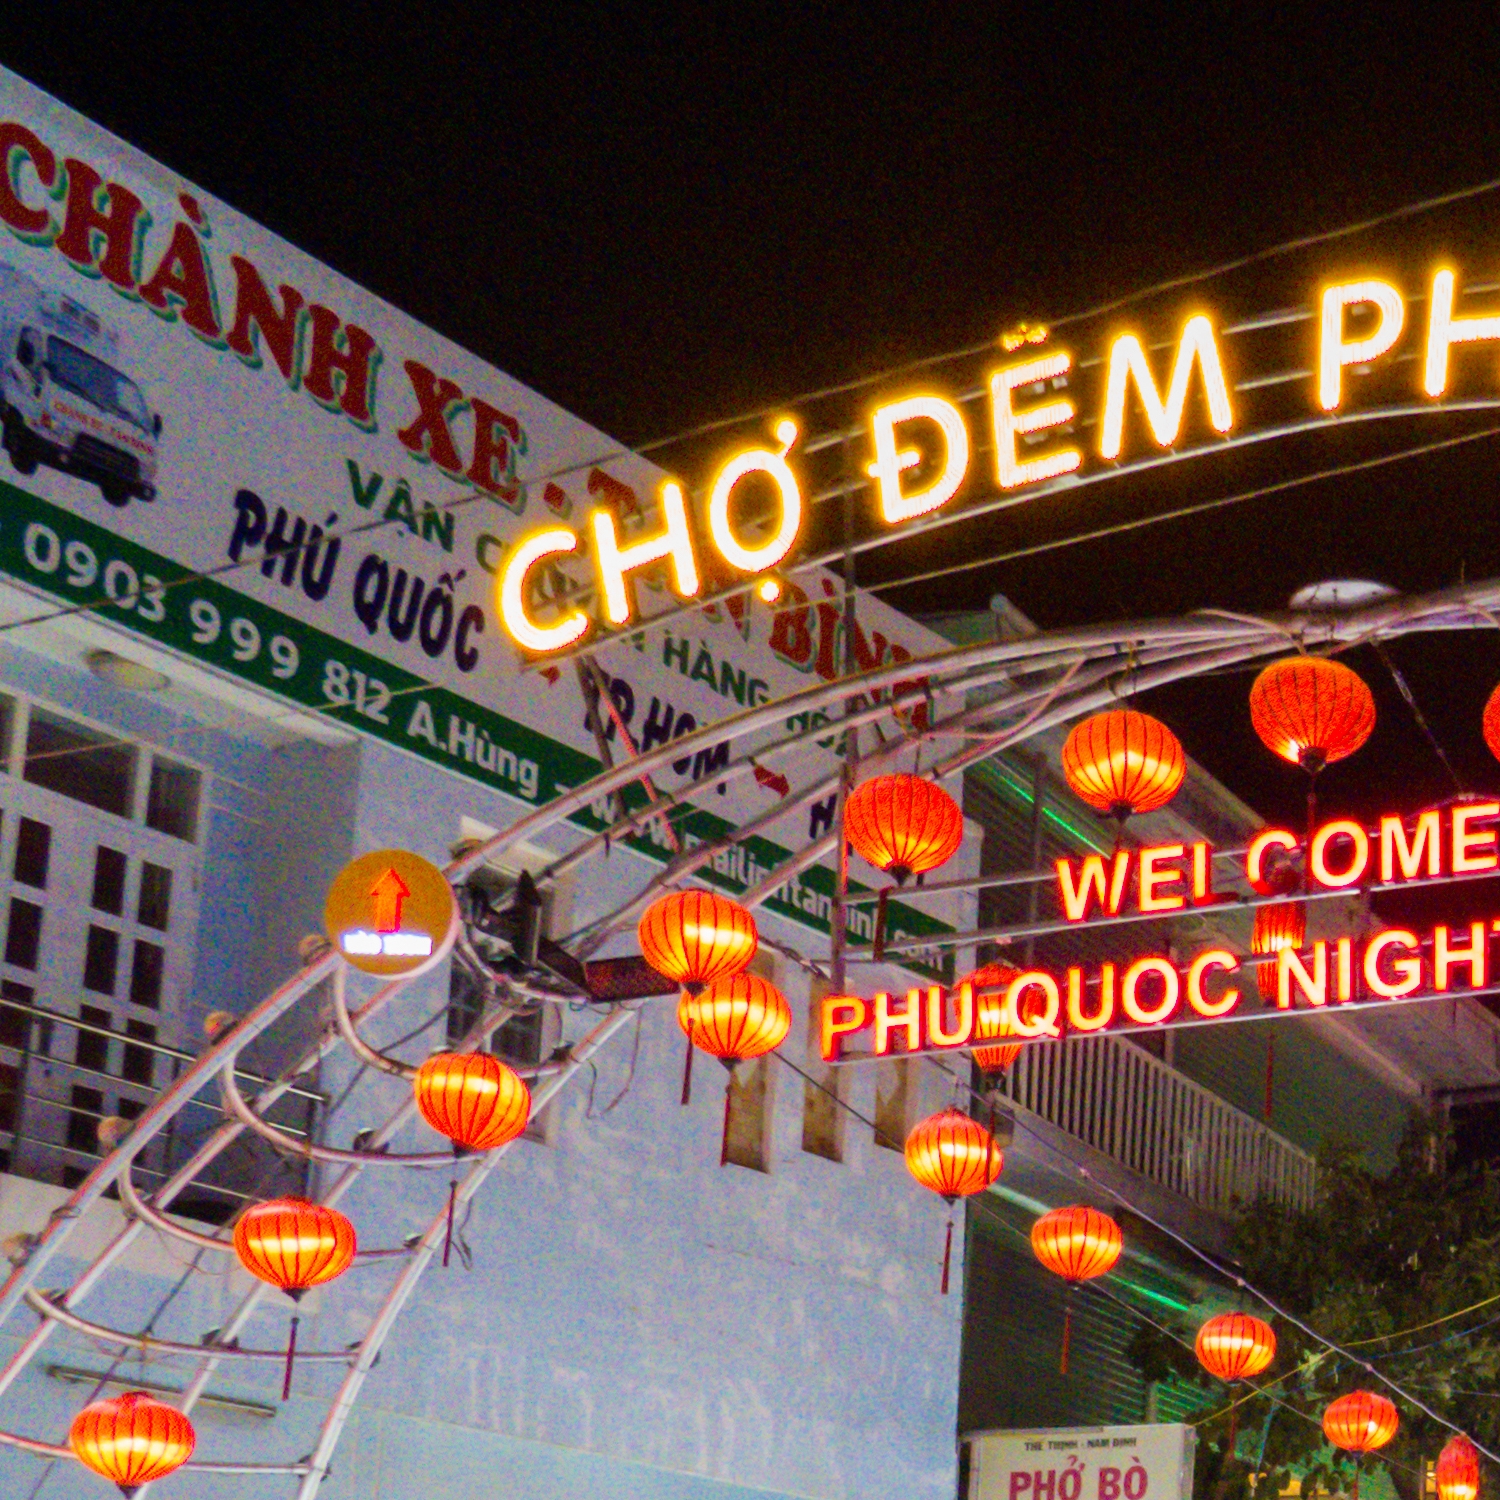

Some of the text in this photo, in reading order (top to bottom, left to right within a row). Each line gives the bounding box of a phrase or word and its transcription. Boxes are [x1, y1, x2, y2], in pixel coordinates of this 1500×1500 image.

[0, 120, 384, 435] CHÀNH
[398, 358, 528, 516] XE
[226, 489, 342, 600] PHÚ
[352, 552, 486, 672] QUỐC
[498, 415, 803, 653] CHỢ
[22, 522, 168, 624] 0903
[189, 600, 301, 680] 999
[322, 659, 391, 726] 812
[407, 700, 540, 799] A.Hùng
[818, 980, 974, 1062] PHU
[1008, 948, 1244, 1040] QUOC
